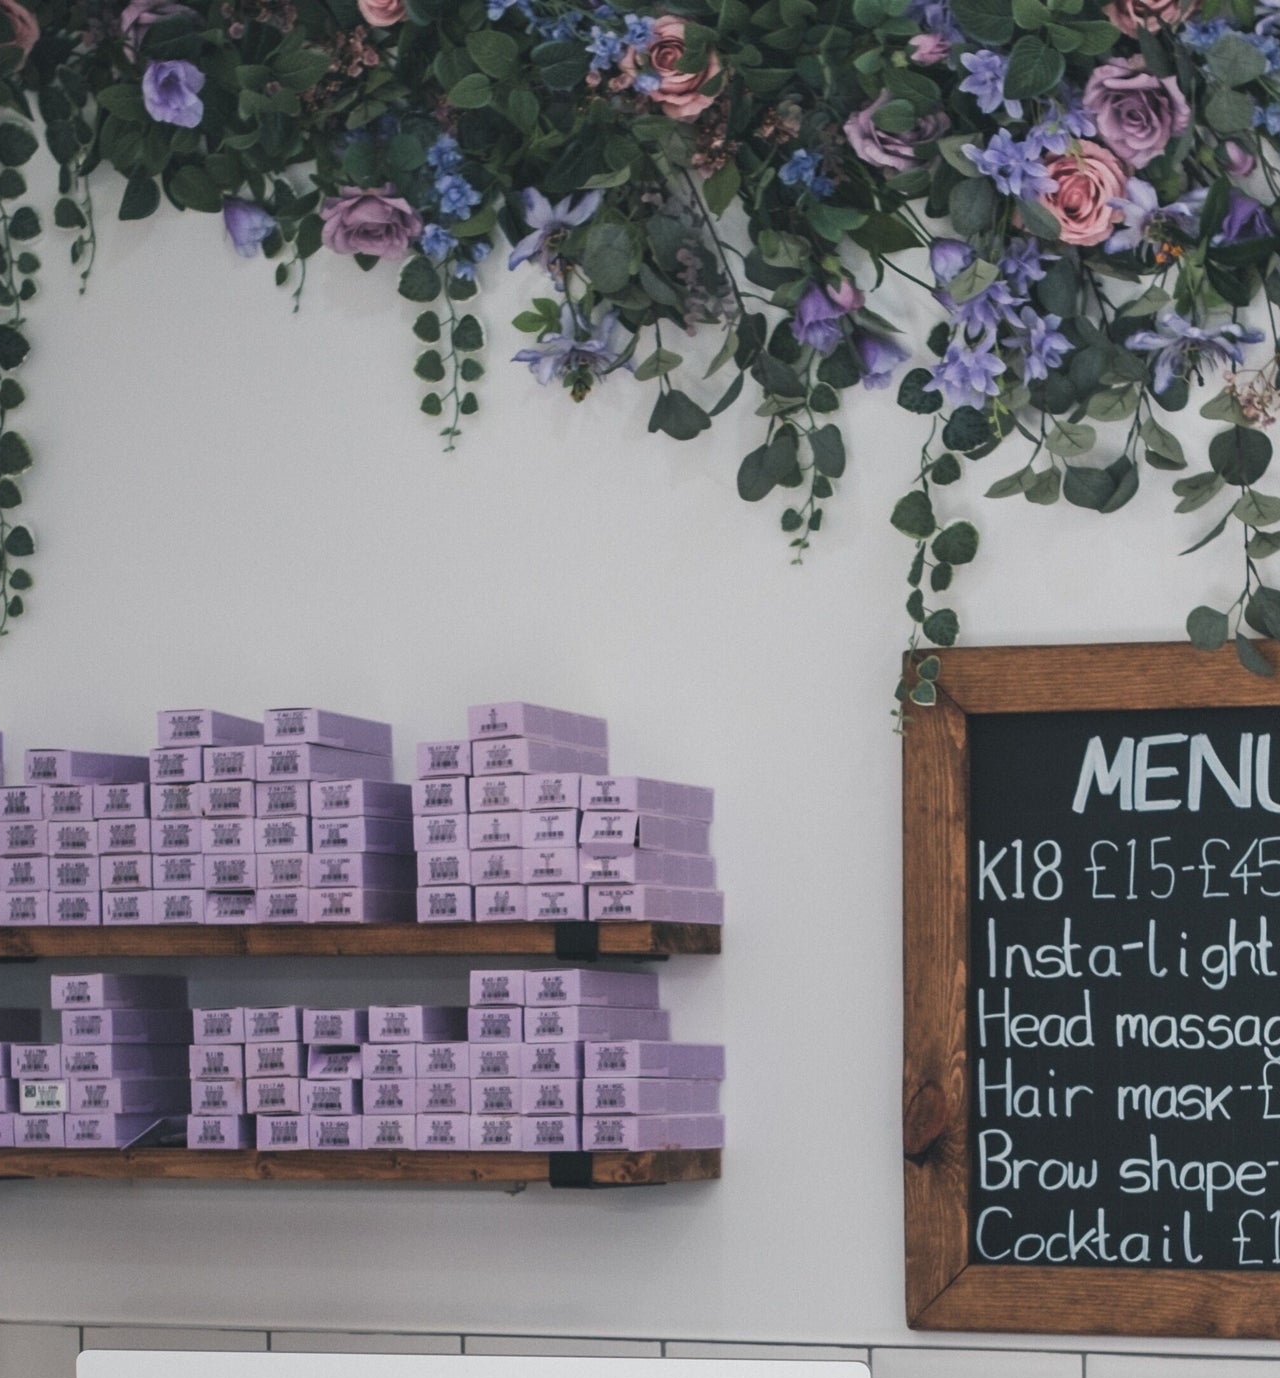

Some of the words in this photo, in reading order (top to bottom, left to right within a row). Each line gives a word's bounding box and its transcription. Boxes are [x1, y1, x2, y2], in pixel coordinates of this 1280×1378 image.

[977, 839, 1063, 902] K18
[977, 987, 1095, 1049] Head
[977, 1057, 1093, 1119] Hair
[977, 1130, 1098, 1191] Brow
[975, 1205, 1203, 1264] Cocktail
